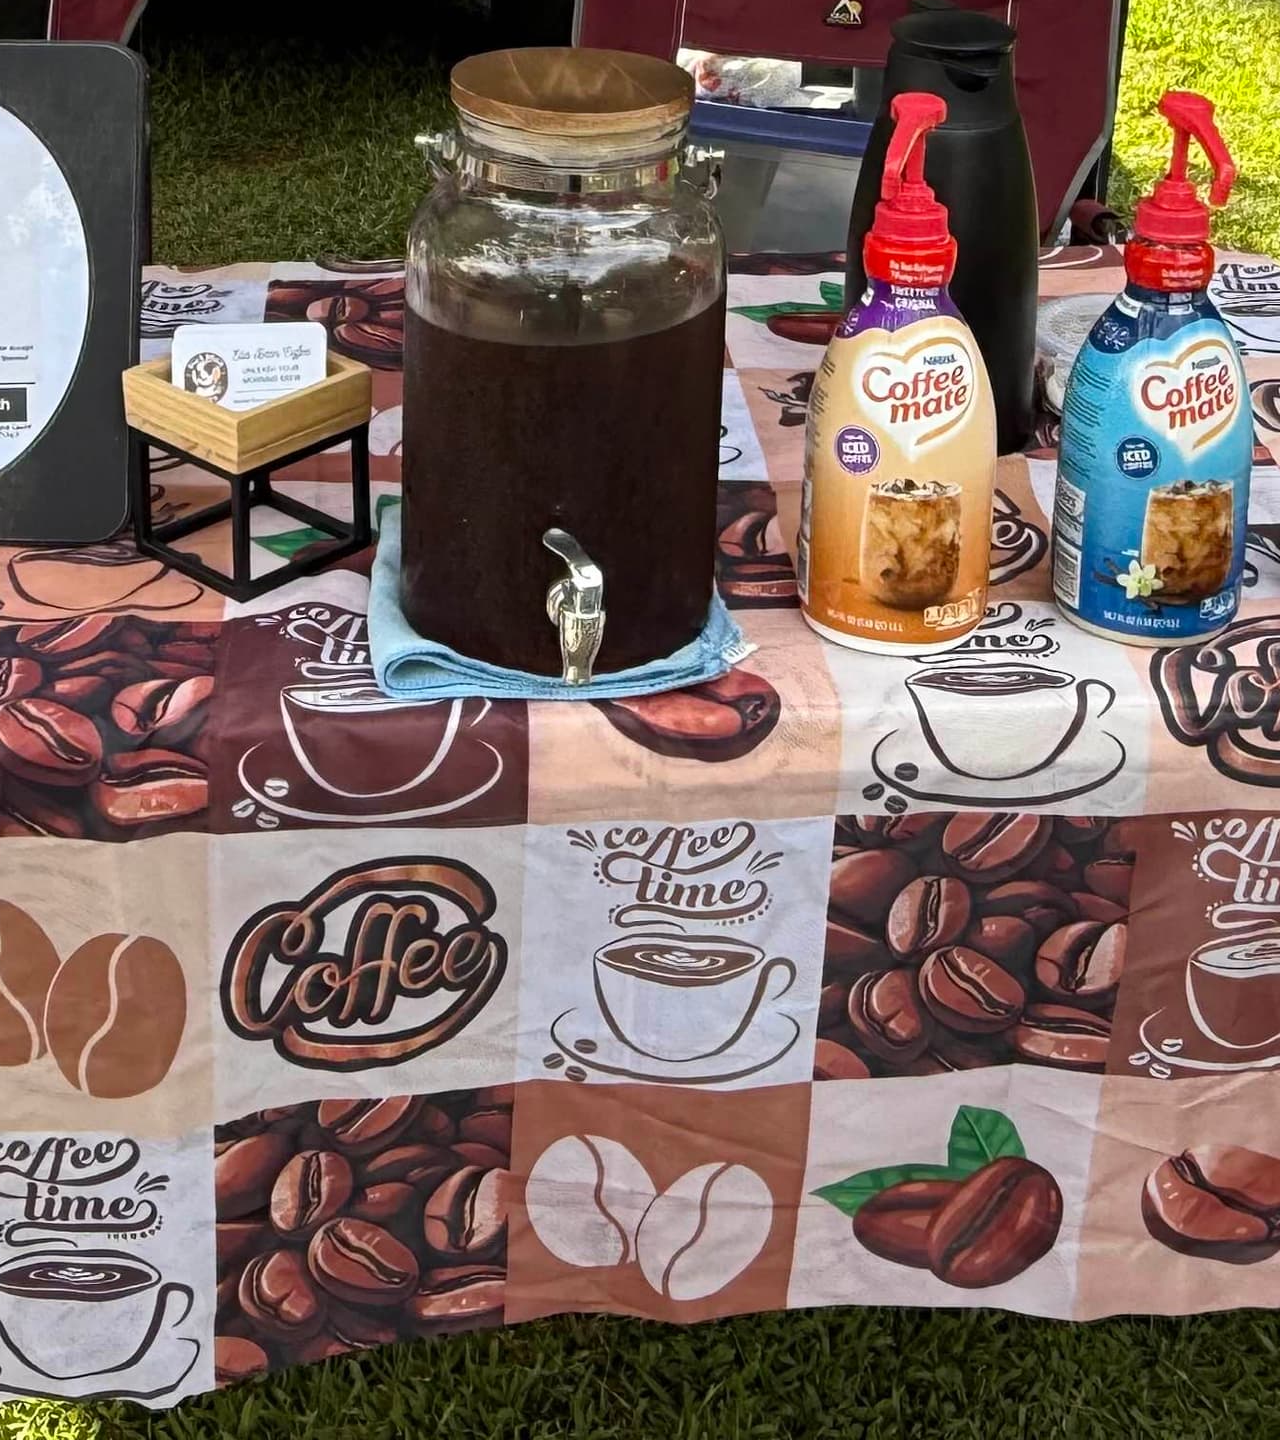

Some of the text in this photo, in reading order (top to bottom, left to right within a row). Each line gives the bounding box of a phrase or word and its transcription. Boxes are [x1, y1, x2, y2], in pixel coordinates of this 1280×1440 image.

[862, 364, 965, 402] Coffee
[889, 384, 968, 424] mate
[1140, 364, 1231, 412] Coffee
[1168, 381, 1235, 430] mate
[1123, 449, 1151, 462] ICED
[288, 607, 369, 643] coff
[603, 820, 757, 872] coffee
[636, 866, 769, 908] time
[219, 855, 508, 1073] Coffee
[23, 1180, 159, 1226] time
